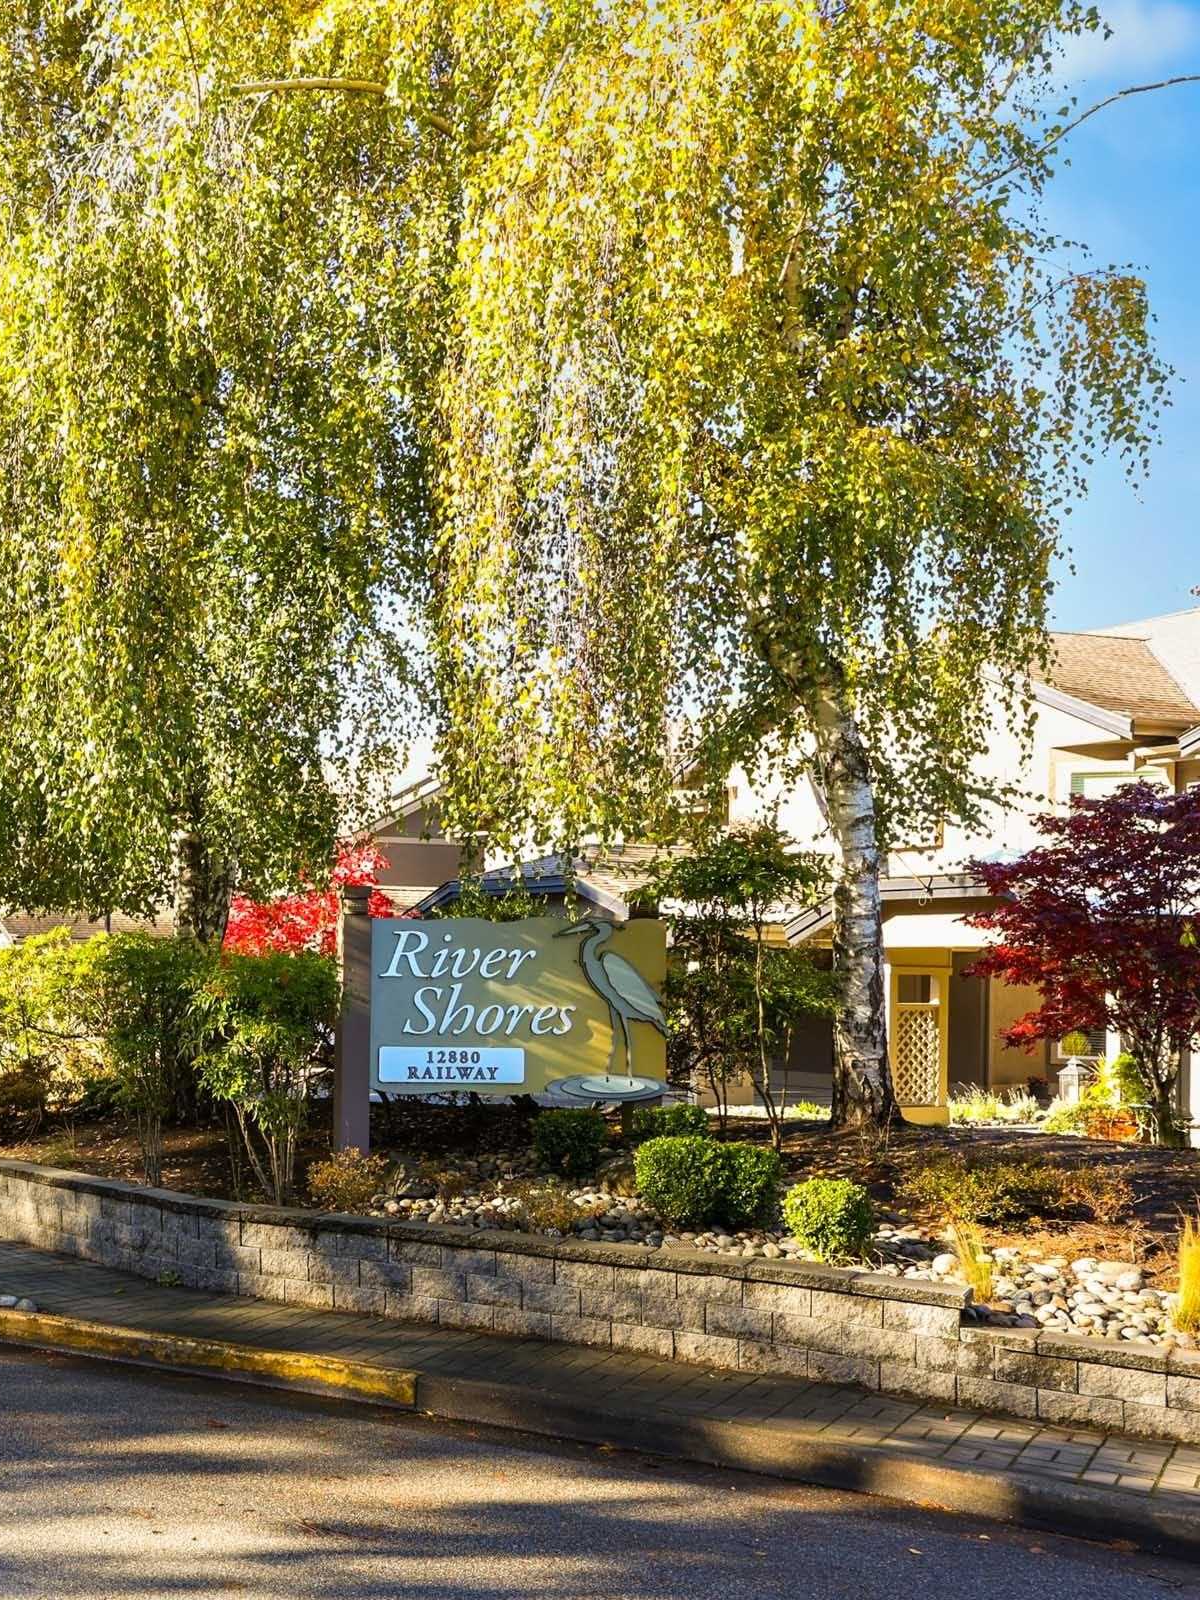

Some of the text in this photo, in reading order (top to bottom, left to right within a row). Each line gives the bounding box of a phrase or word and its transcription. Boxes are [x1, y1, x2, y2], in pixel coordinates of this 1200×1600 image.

[378, 930, 536, 980] River
[402, 983, 577, 1036] Shores
[407, 1066, 499, 1080] RAILWAY
[426, 1051, 481, 1064] 12880
